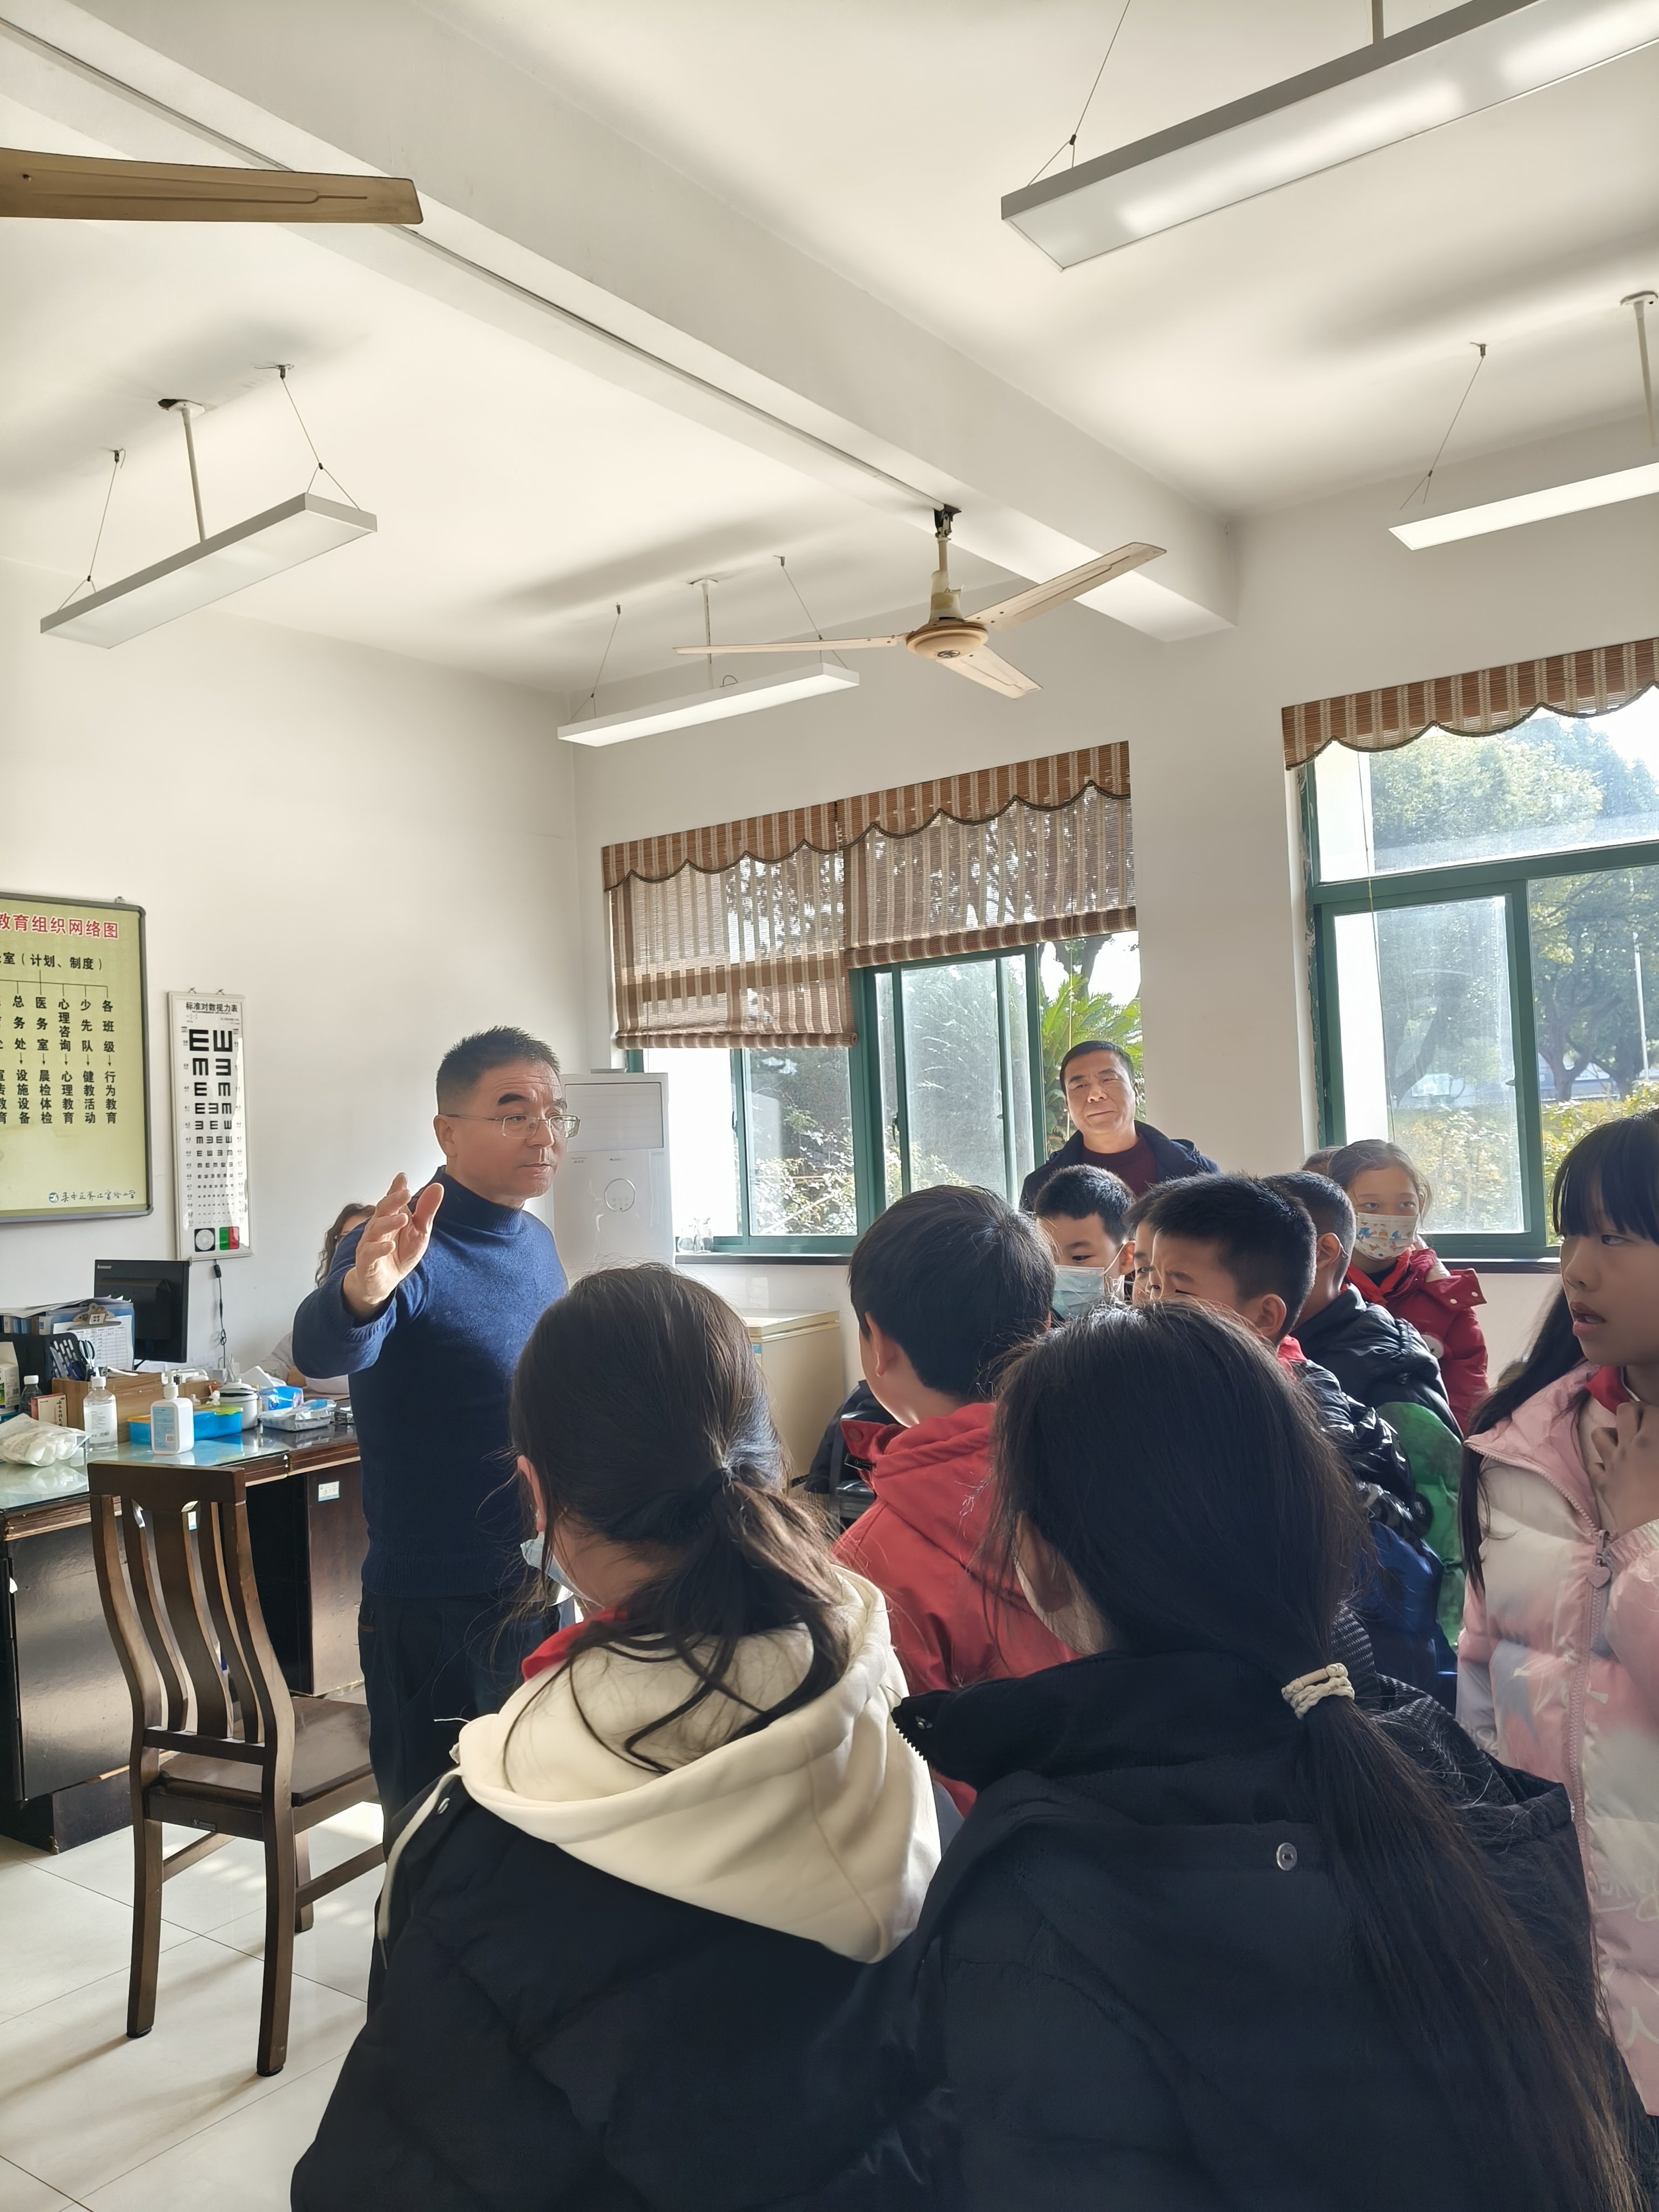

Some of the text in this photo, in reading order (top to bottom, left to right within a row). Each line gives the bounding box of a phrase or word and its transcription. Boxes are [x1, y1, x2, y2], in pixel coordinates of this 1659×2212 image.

[0, 913, 118, 939] 教育组织网络图
[0, 952, 102, 970] 室（计划、制度）
[13, 995, 26, 1050] 总务处
[36, 996, 49, 1051] 医务室
[58, 999, 71, 1051] 心理咨询
[80, 999, 93, 1052] 少先队
[102, 1000, 115, 1053] 各班级
[186, 1002, 238, 1013] 标准对数视力表
[16, 1069, 30, 1124] 设施设备
[39, 1070, 52, 1124] 晨检体检
[62, 1070, 74, 1124] 心理教育
[83, 1070, 96, 1124] 健教活动
[104, 1071, 117, 1124] 行为教育
